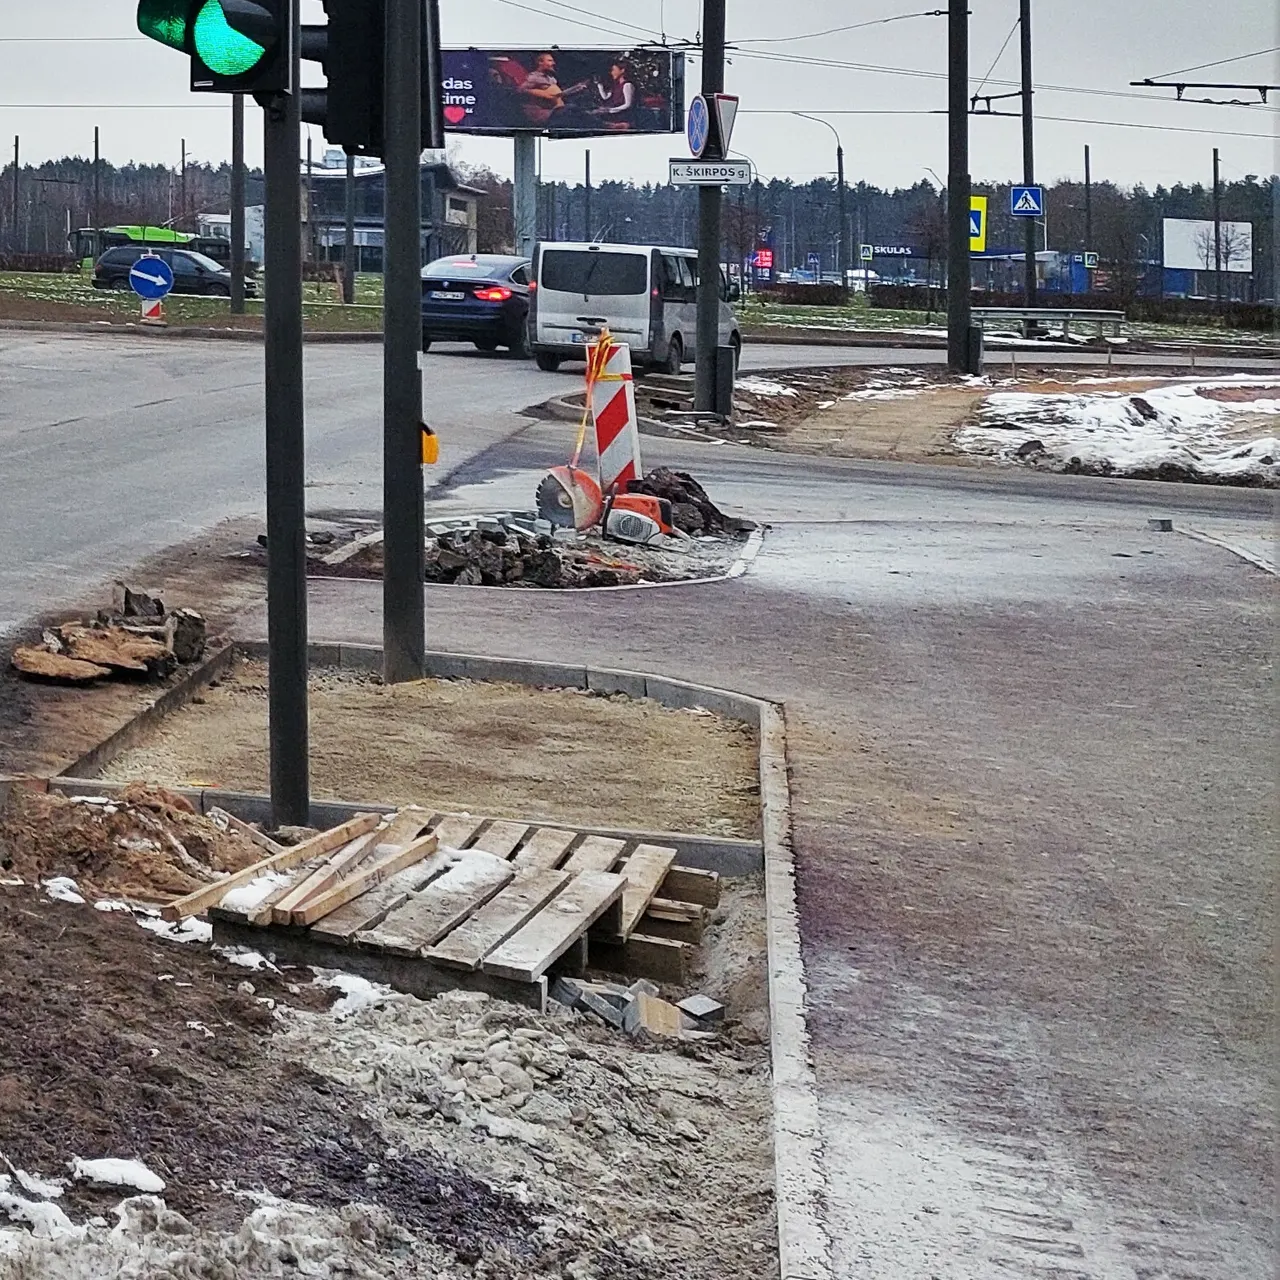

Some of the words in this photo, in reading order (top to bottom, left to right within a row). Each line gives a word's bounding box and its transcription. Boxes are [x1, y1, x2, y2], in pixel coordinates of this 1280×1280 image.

[441, 77, 473, 90] das
[672, 167, 684, 177] K.
[685, 165, 735, 177] ŠKIRPOS
[737, 169, 748, 179] g.
[874, 246, 912, 255] SKULAS
